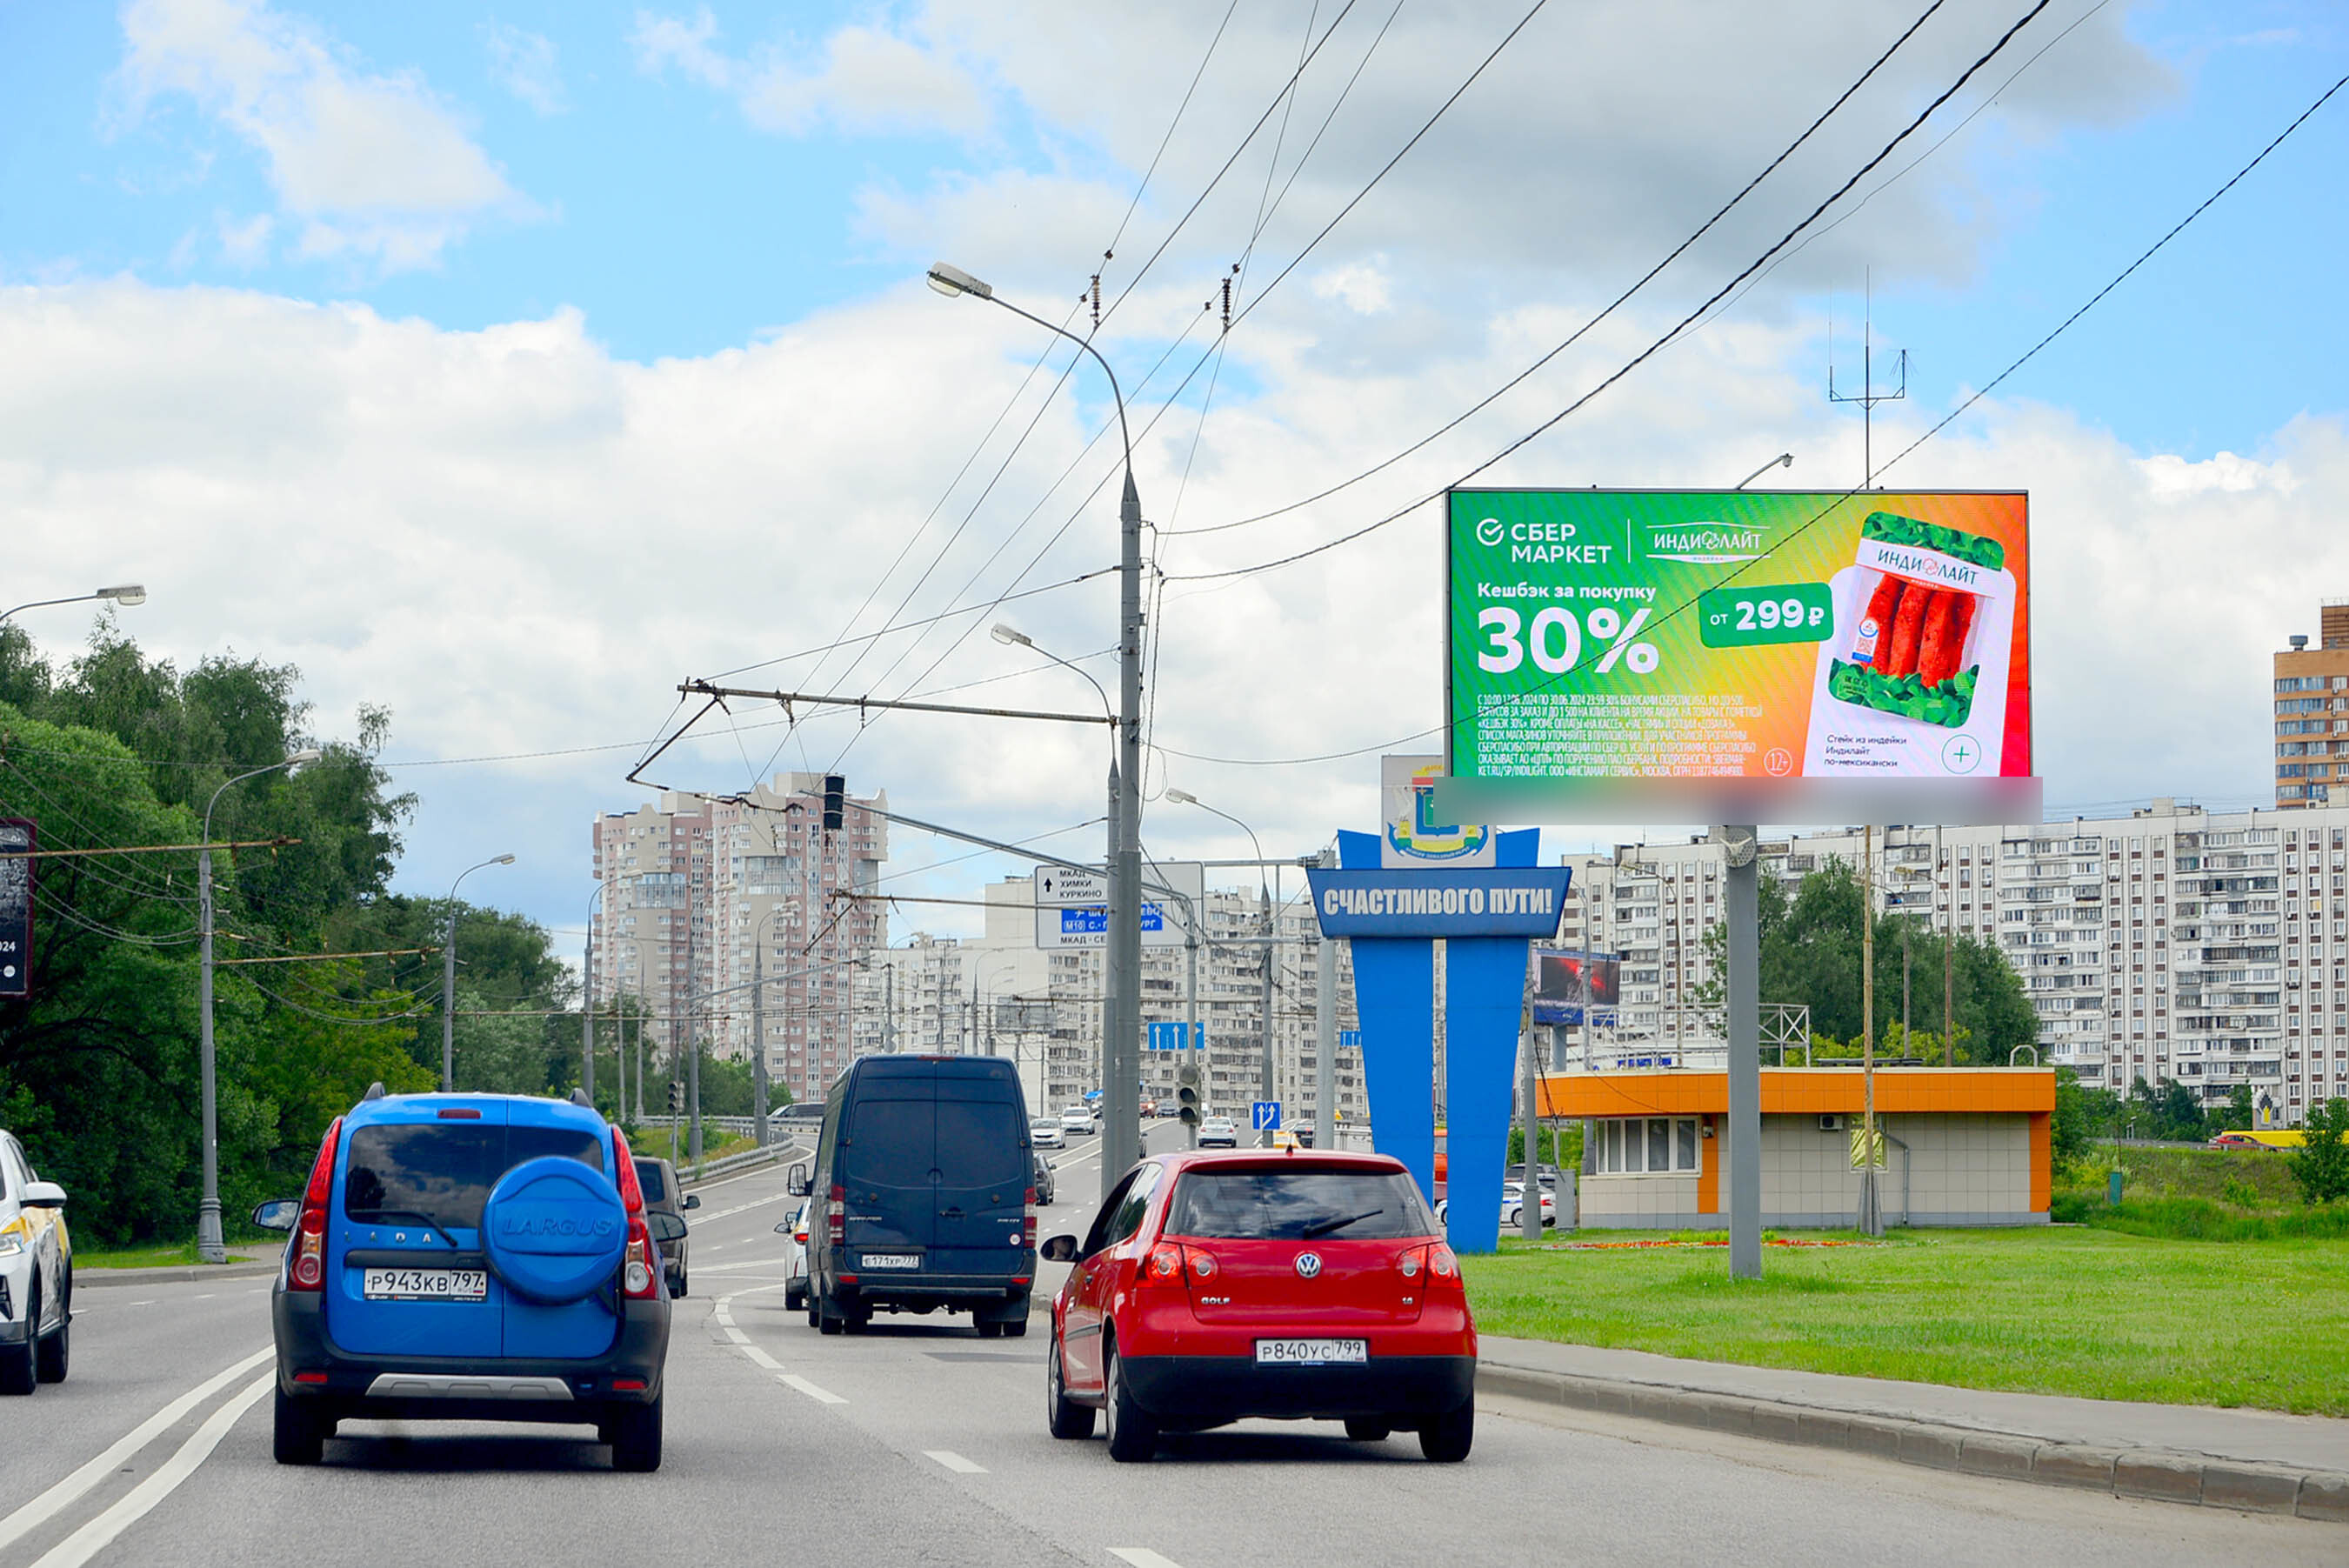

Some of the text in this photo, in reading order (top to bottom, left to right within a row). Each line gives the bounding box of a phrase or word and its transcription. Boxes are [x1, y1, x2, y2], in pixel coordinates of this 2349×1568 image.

[1511, 523, 1577, 542] СБЕР
[1512, 544, 1612, 564] МАРКЕТ
[1478, 581, 1657, 603] Кешбэк за покупку
[1478, 606, 1660, 674] 30%
[1826, 734, 1854, 744] Стейк
[1868, 736, 1907, 746] индейки
[1825, 746, 1870, 756] Индилайт
[1824, 758, 1898, 767] по-мексикански
[1059, 870, 1086, 878] МКАД
[1059, 890, 1103, 898] КУРКИНО
[1323, 888, 1553, 916] СЧАСТЛИВОГО ПУТИ!
[1060, 936, 1087, 944] МКАД
[501, 1216, 612, 1238] LARGUS
[370, 1271, 482, 1292] Р943КВ 797
[1263, 1340, 1361, 1360] Р840УС 799
